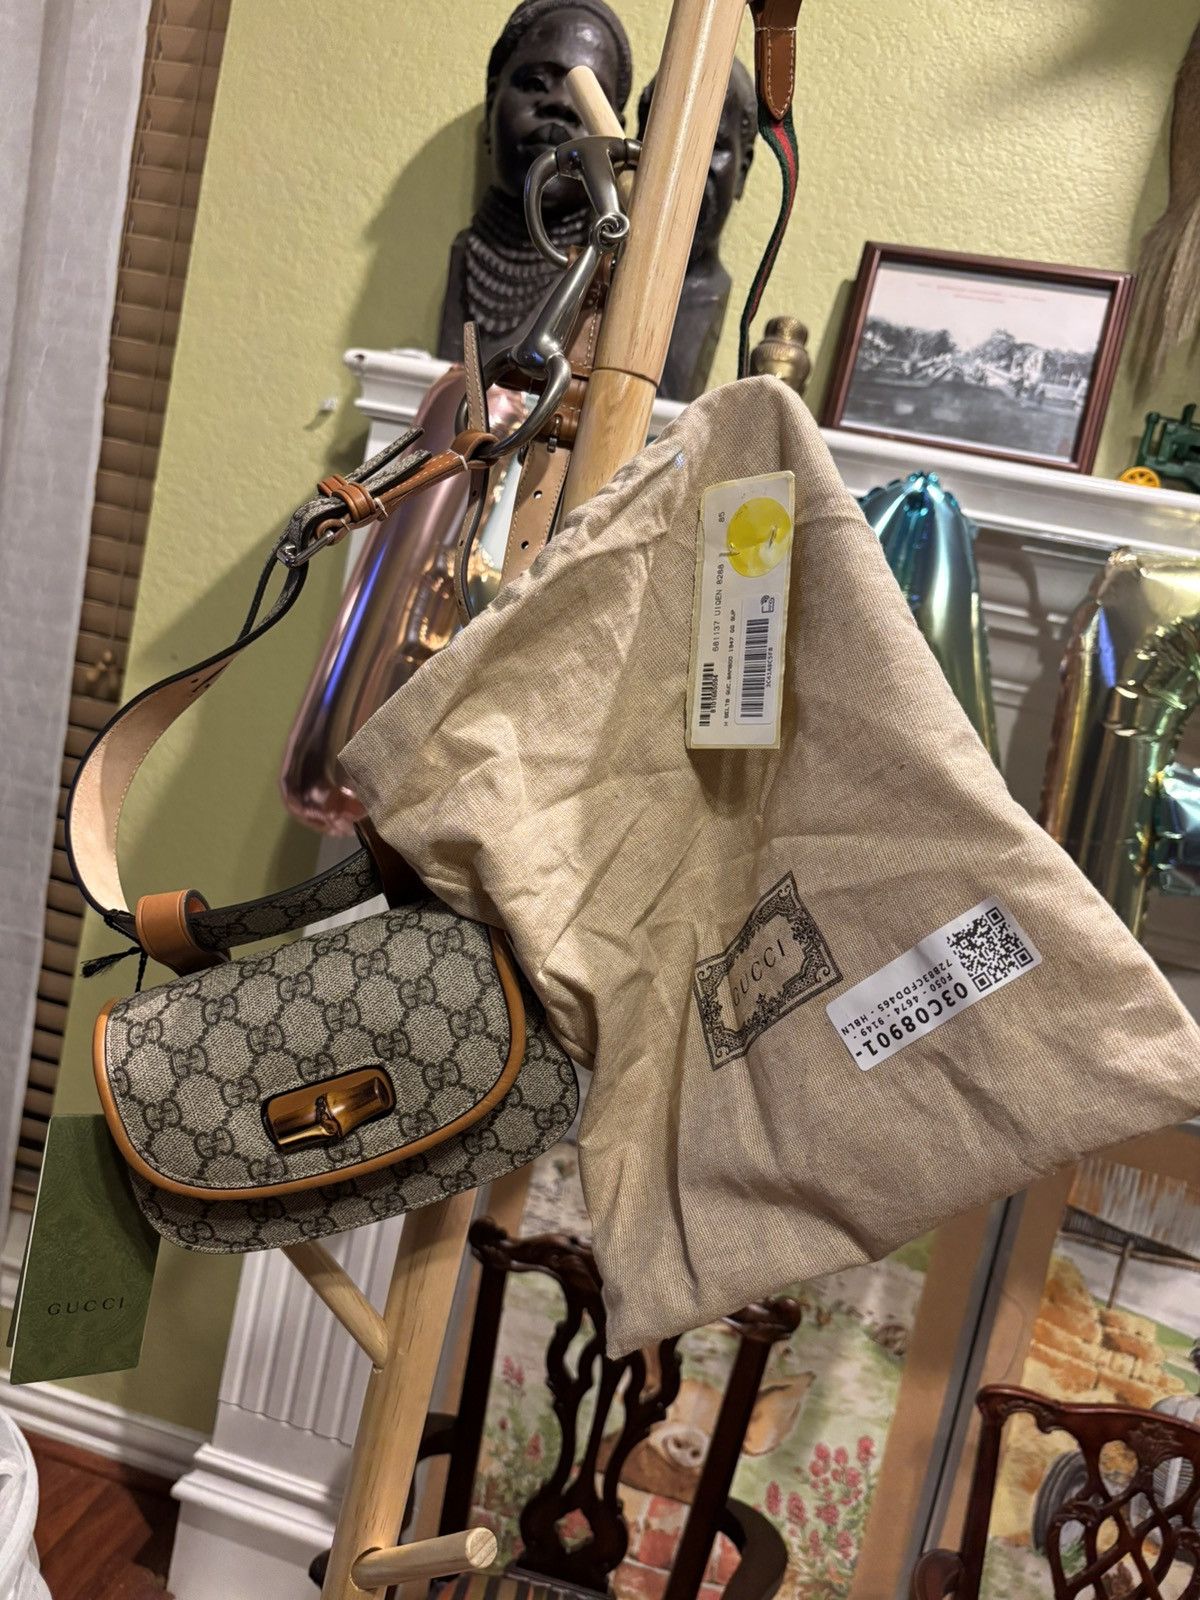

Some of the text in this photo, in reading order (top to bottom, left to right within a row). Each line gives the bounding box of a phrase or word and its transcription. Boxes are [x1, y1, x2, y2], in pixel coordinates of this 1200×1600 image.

[718, 511, 725, 523] 85
[731, 938, 786, 1007] GUCCI
[929, 972, 954, 993] F050
[893, 994, 919, 1016] 4674
[840, 1013, 869, 1037] HBLN
[855, 981, 969, 1058] 03C08901-
[859, 1017, 885, 1038] 9149
[47, 1296, 125, 1316] GUCCI
